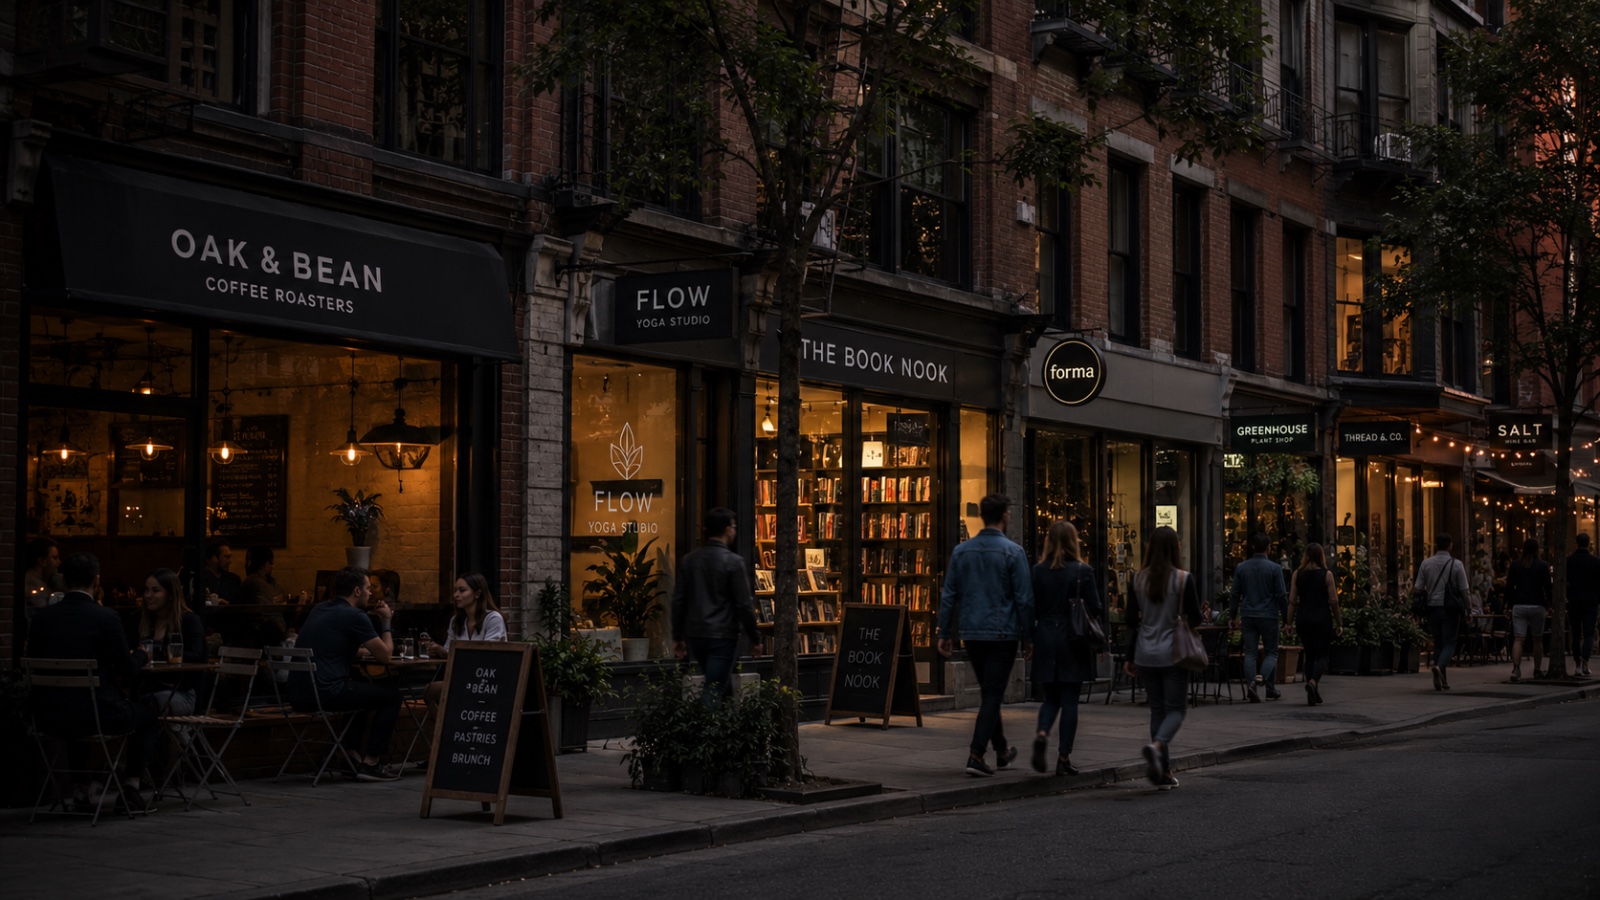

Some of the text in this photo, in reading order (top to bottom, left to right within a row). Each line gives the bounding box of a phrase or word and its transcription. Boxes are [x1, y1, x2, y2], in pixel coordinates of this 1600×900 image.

[171, 228, 383, 293] OAK & BEAN
[205, 276, 354, 314] COFFEE ROASTERS
[636, 284, 711, 311] FLOW
[636, 315, 711, 328] YOGA STUDIO
[801, 338, 948, 384] THE BOOK NOOK
[1050, 363, 1095, 380] forma
[1236, 424, 1308, 436] GREENHOUSE
[1344, 432, 1378, 442] THREAD
[1380, 432, 1388, 442] &
[1497, 423, 1543, 437] SALT
[1275, 436, 1294, 444] SHOP
[594, 490, 654, 513] FLOW
[588, 521, 617, 534] YOGA
[859, 627, 881, 641] THE
[848, 650, 885, 665] BOOK
[475, 667, 497, 679] OAK
[844, 673, 881, 689] NOOK
[460, 709, 497, 722] COFFEE
[453, 731, 497, 744] PASTRIES
[452, 752, 491, 765] BRUNCH
